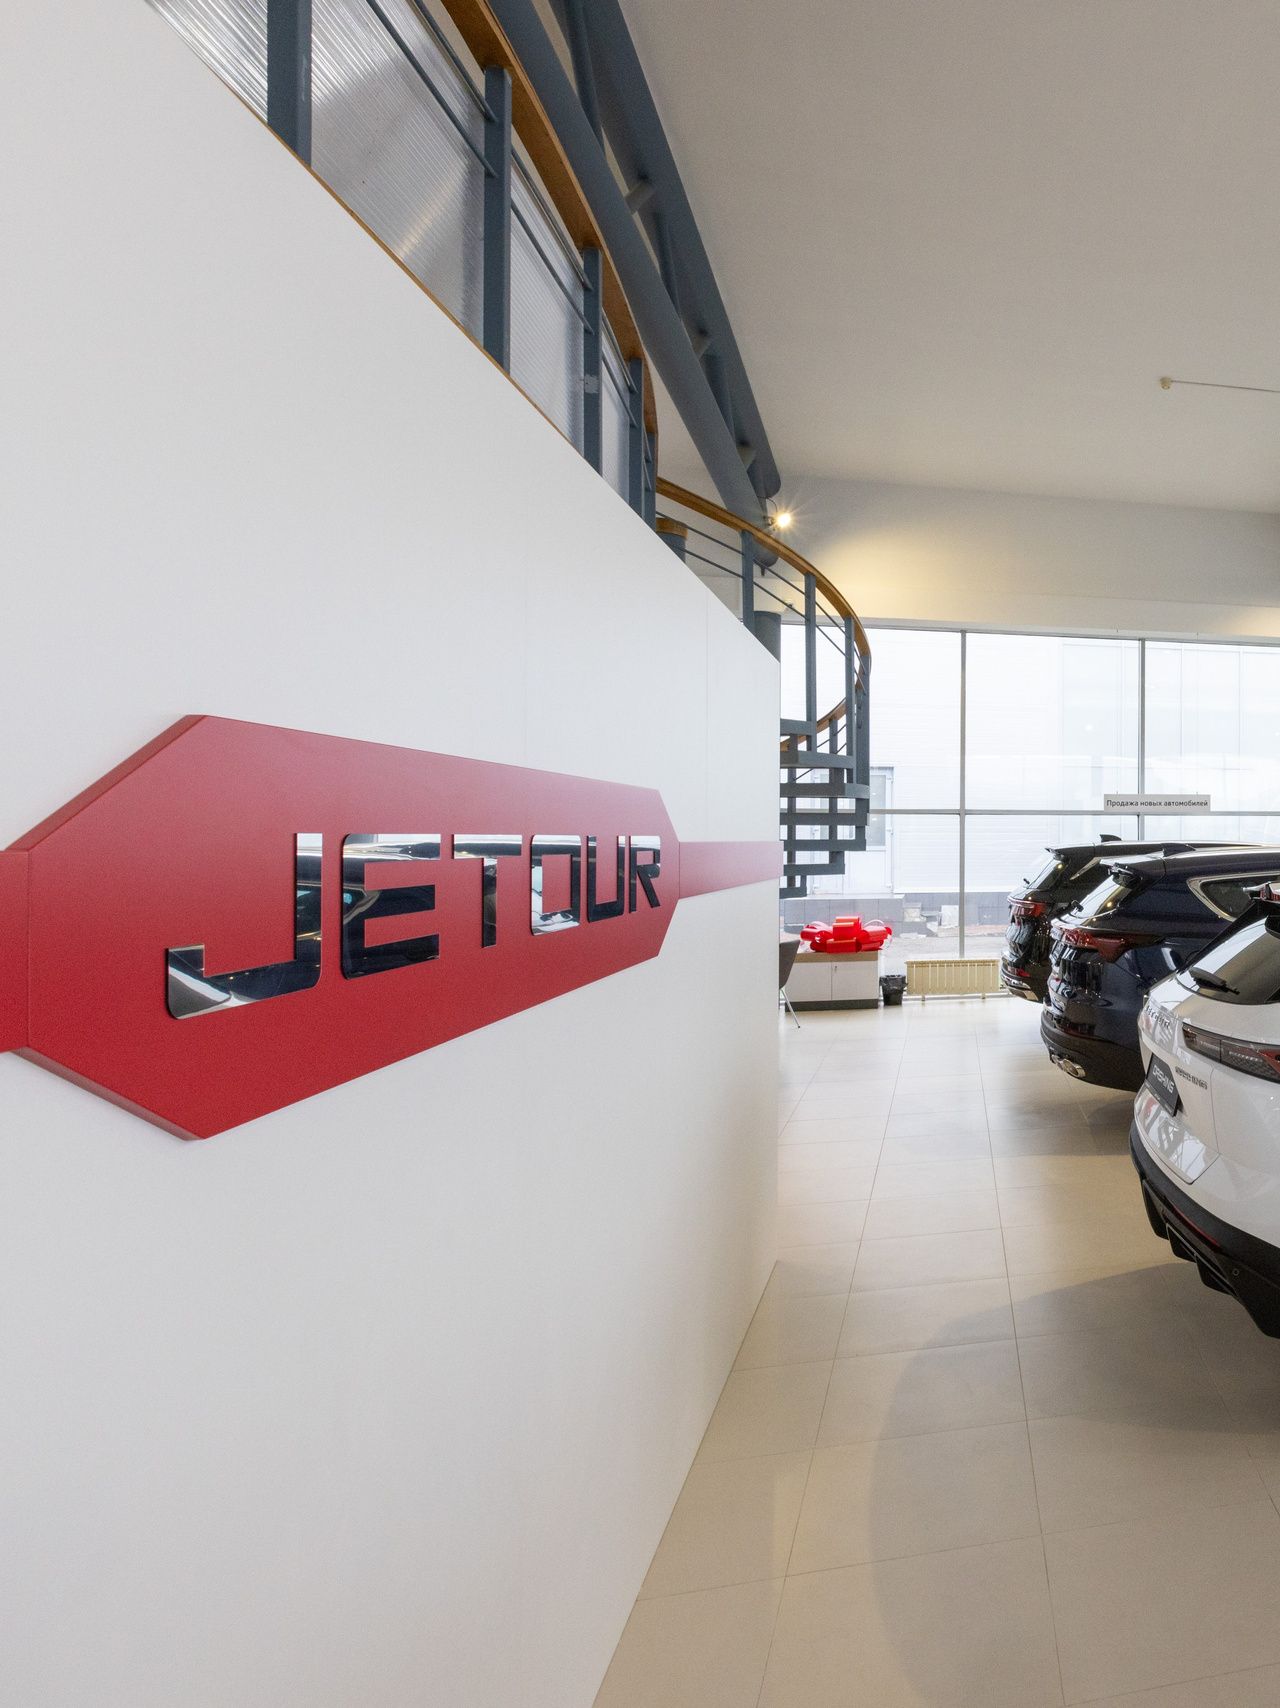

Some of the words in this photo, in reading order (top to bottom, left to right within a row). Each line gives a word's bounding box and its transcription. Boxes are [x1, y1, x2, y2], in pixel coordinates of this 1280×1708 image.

[1106, 799, 1139, 807] Продажа
[1164, 799, 1208, 807] автомобилей
[166, 832, 661, 1020] JETOUR
